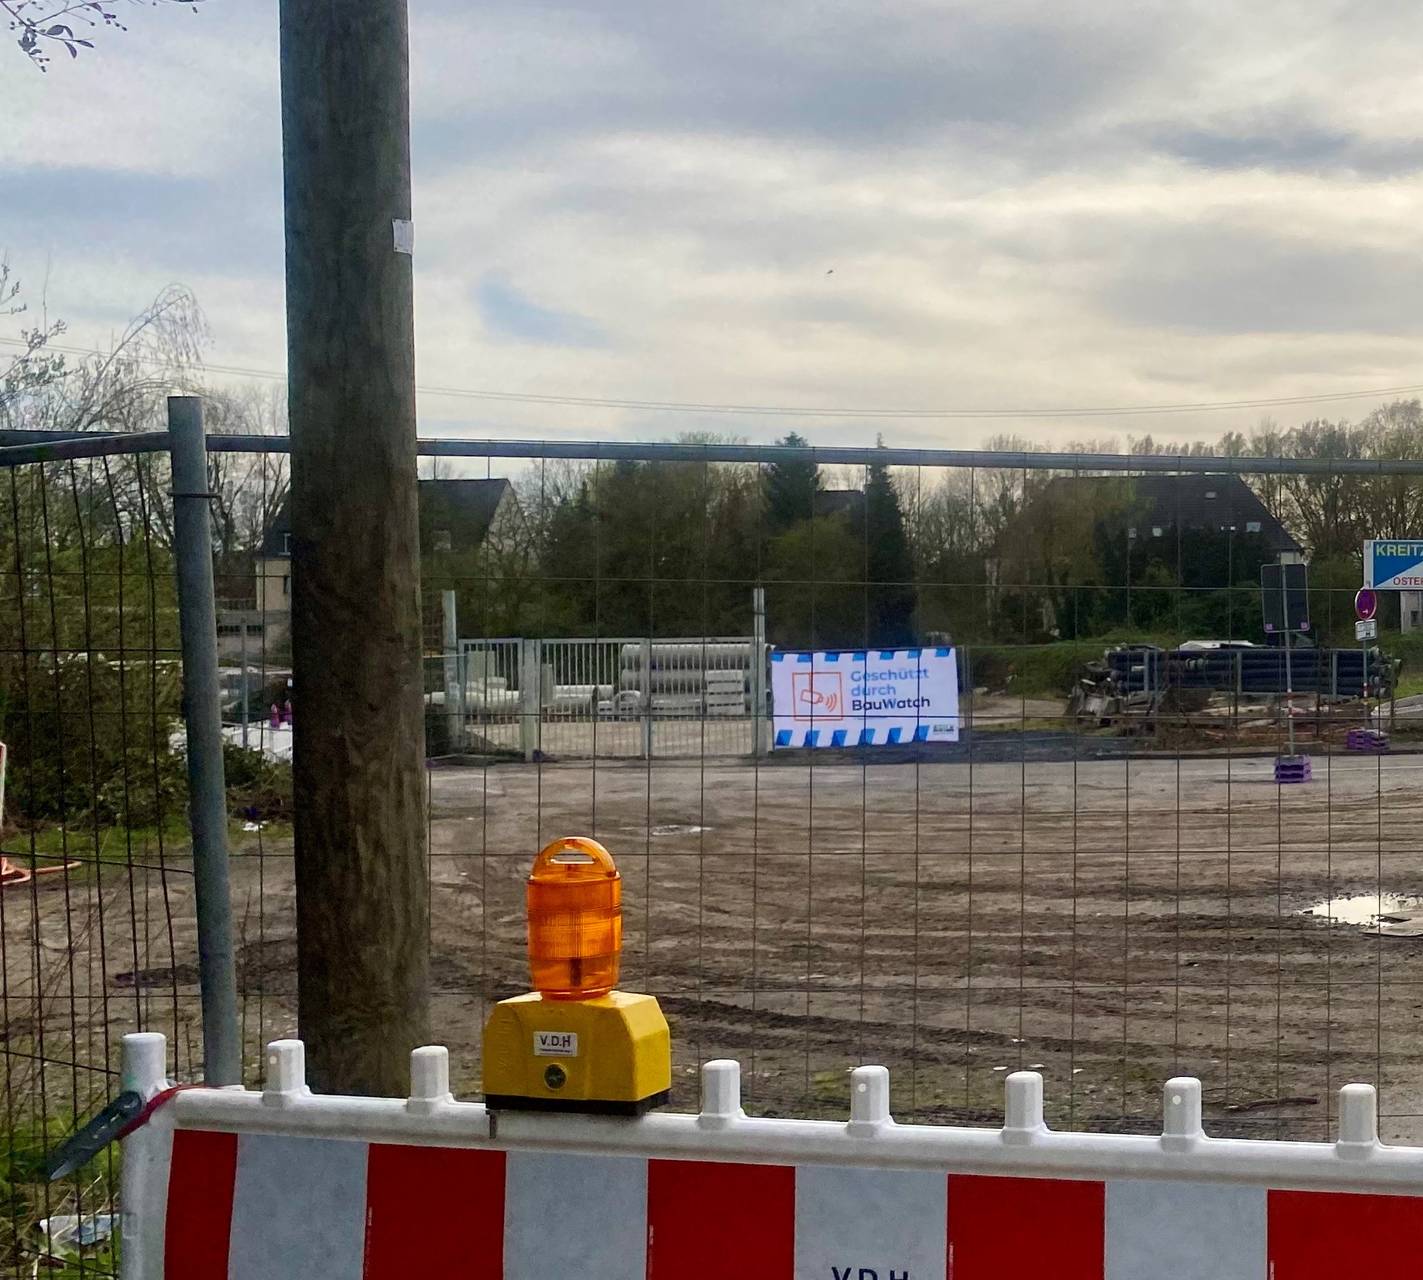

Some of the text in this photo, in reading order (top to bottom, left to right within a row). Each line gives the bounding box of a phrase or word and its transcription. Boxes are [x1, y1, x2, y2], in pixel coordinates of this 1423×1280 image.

[851, 667, 929, 682] Geschützt
[851, 684, 896, 697] durch
[852, 696, 930, 711] BauWatch
[540, 1035, 571, 1048] V.D.H
